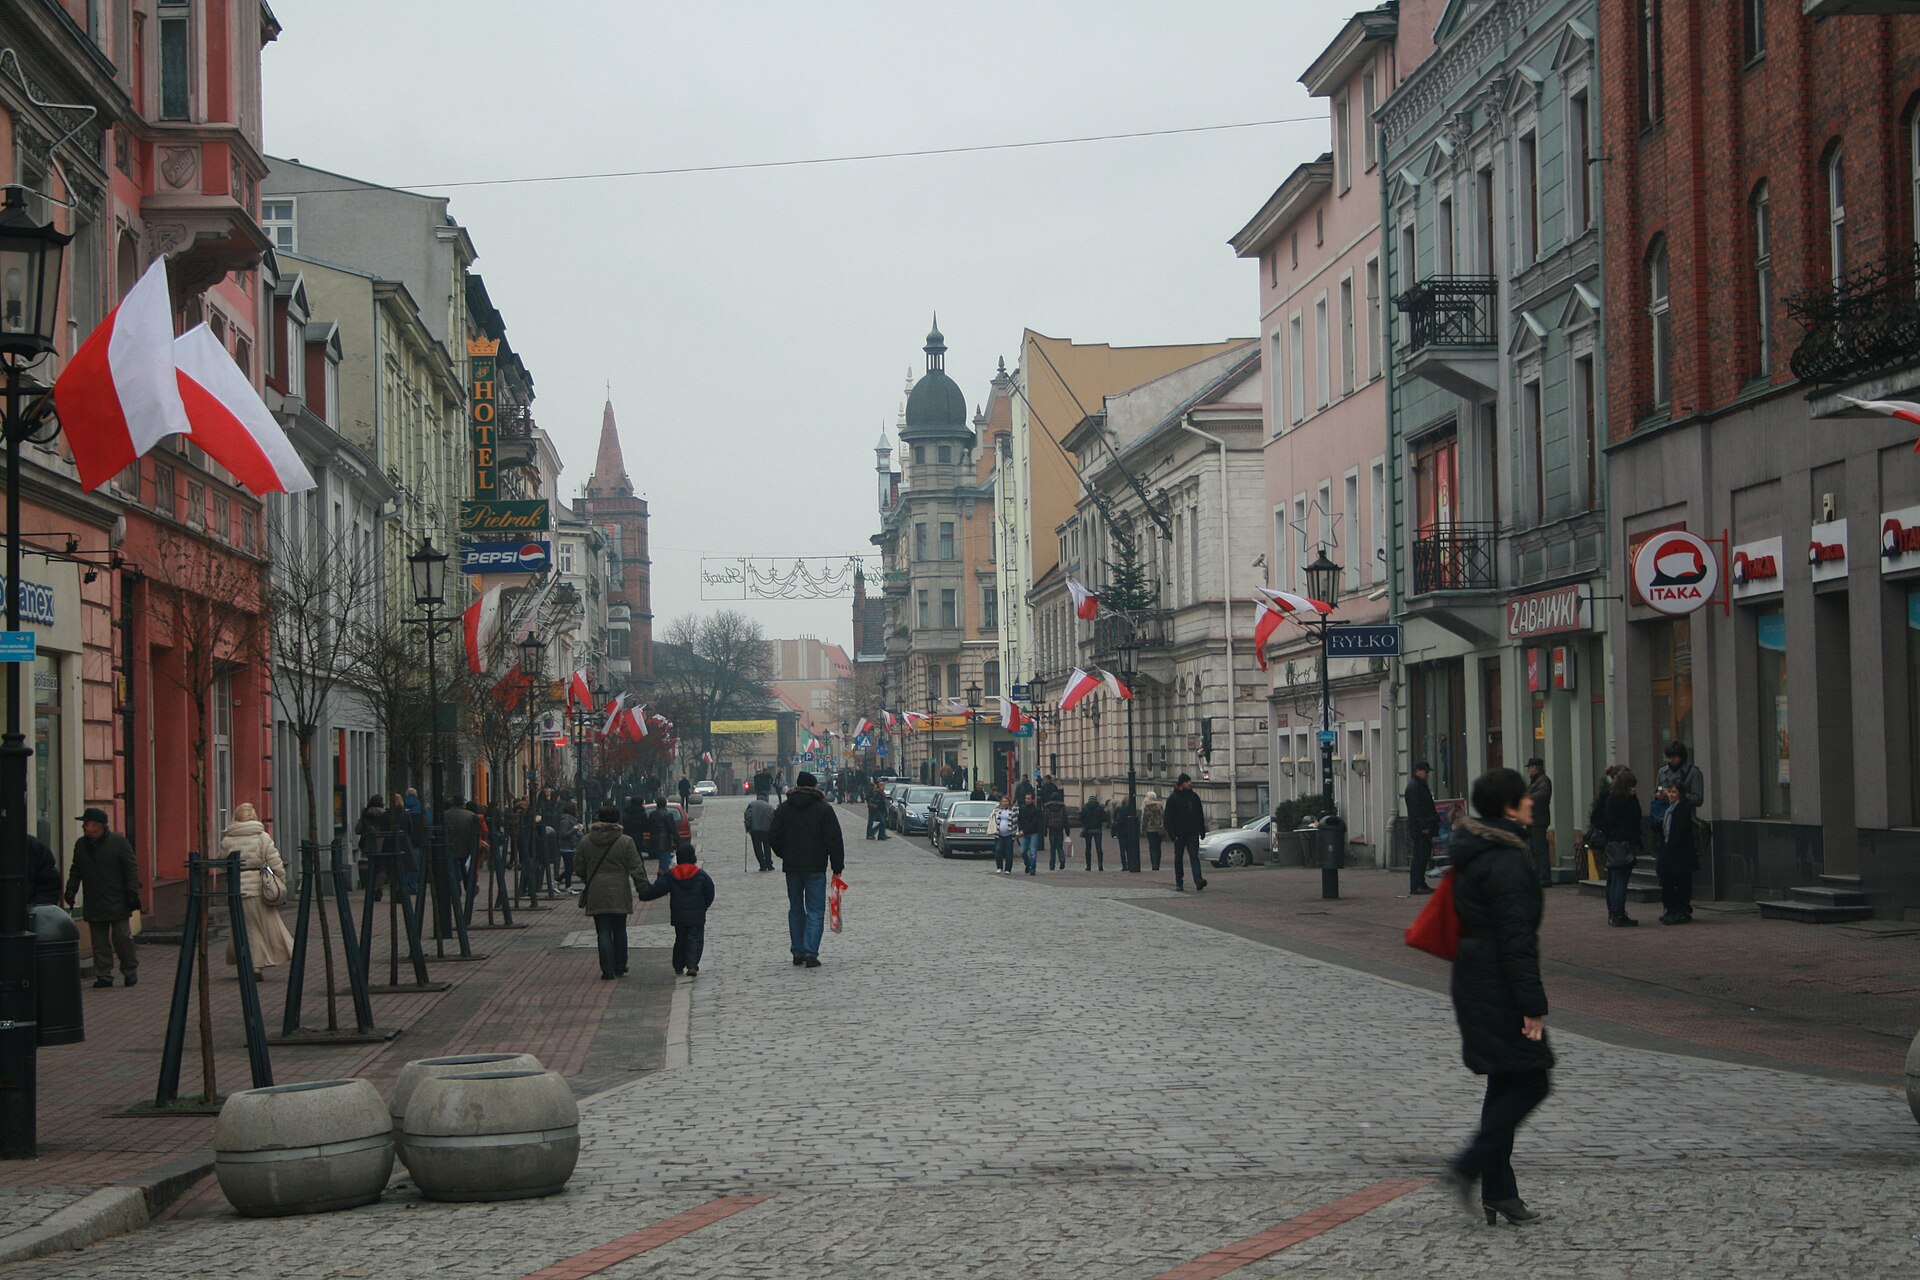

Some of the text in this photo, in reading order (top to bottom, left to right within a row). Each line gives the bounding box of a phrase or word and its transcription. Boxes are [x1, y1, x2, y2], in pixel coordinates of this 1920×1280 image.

[473, 381, 495, 490] HOTEL
[463, 504, 545, 529] Pietrak
[466, 551, 518, 565] PEPSI
[1649, 586, 1702, 601] ITAKA
[1510, 591, 1575, 635] ZABAWKI
[1332, 634, 1395, 648] RYŁKO
